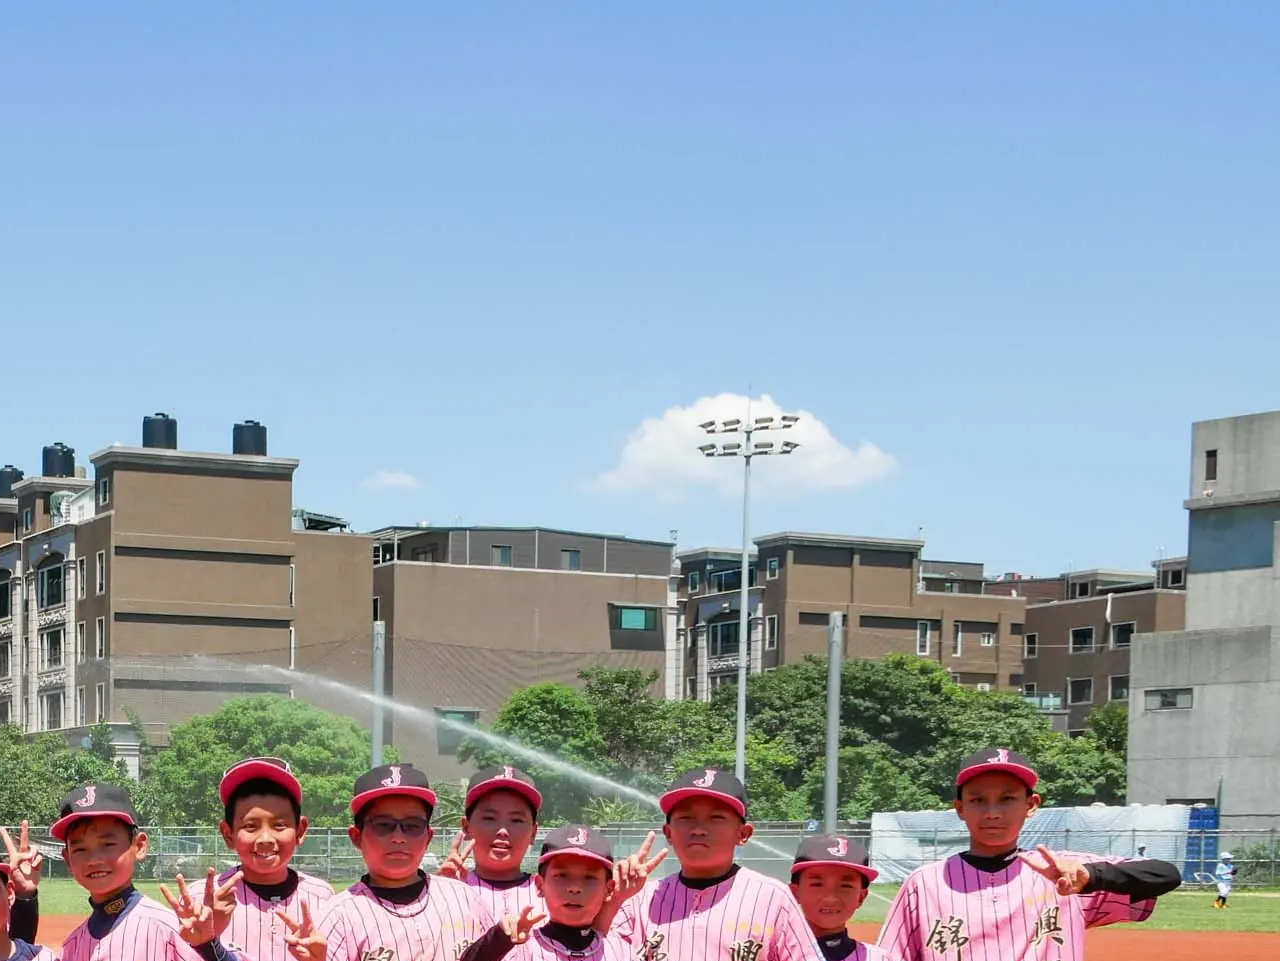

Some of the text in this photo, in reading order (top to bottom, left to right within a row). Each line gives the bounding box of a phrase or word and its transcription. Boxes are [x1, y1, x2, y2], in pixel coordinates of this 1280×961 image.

[381, 766, 402, 786] J
[693, 769, 717, 788] J
[76, 786, 96, 807] J
